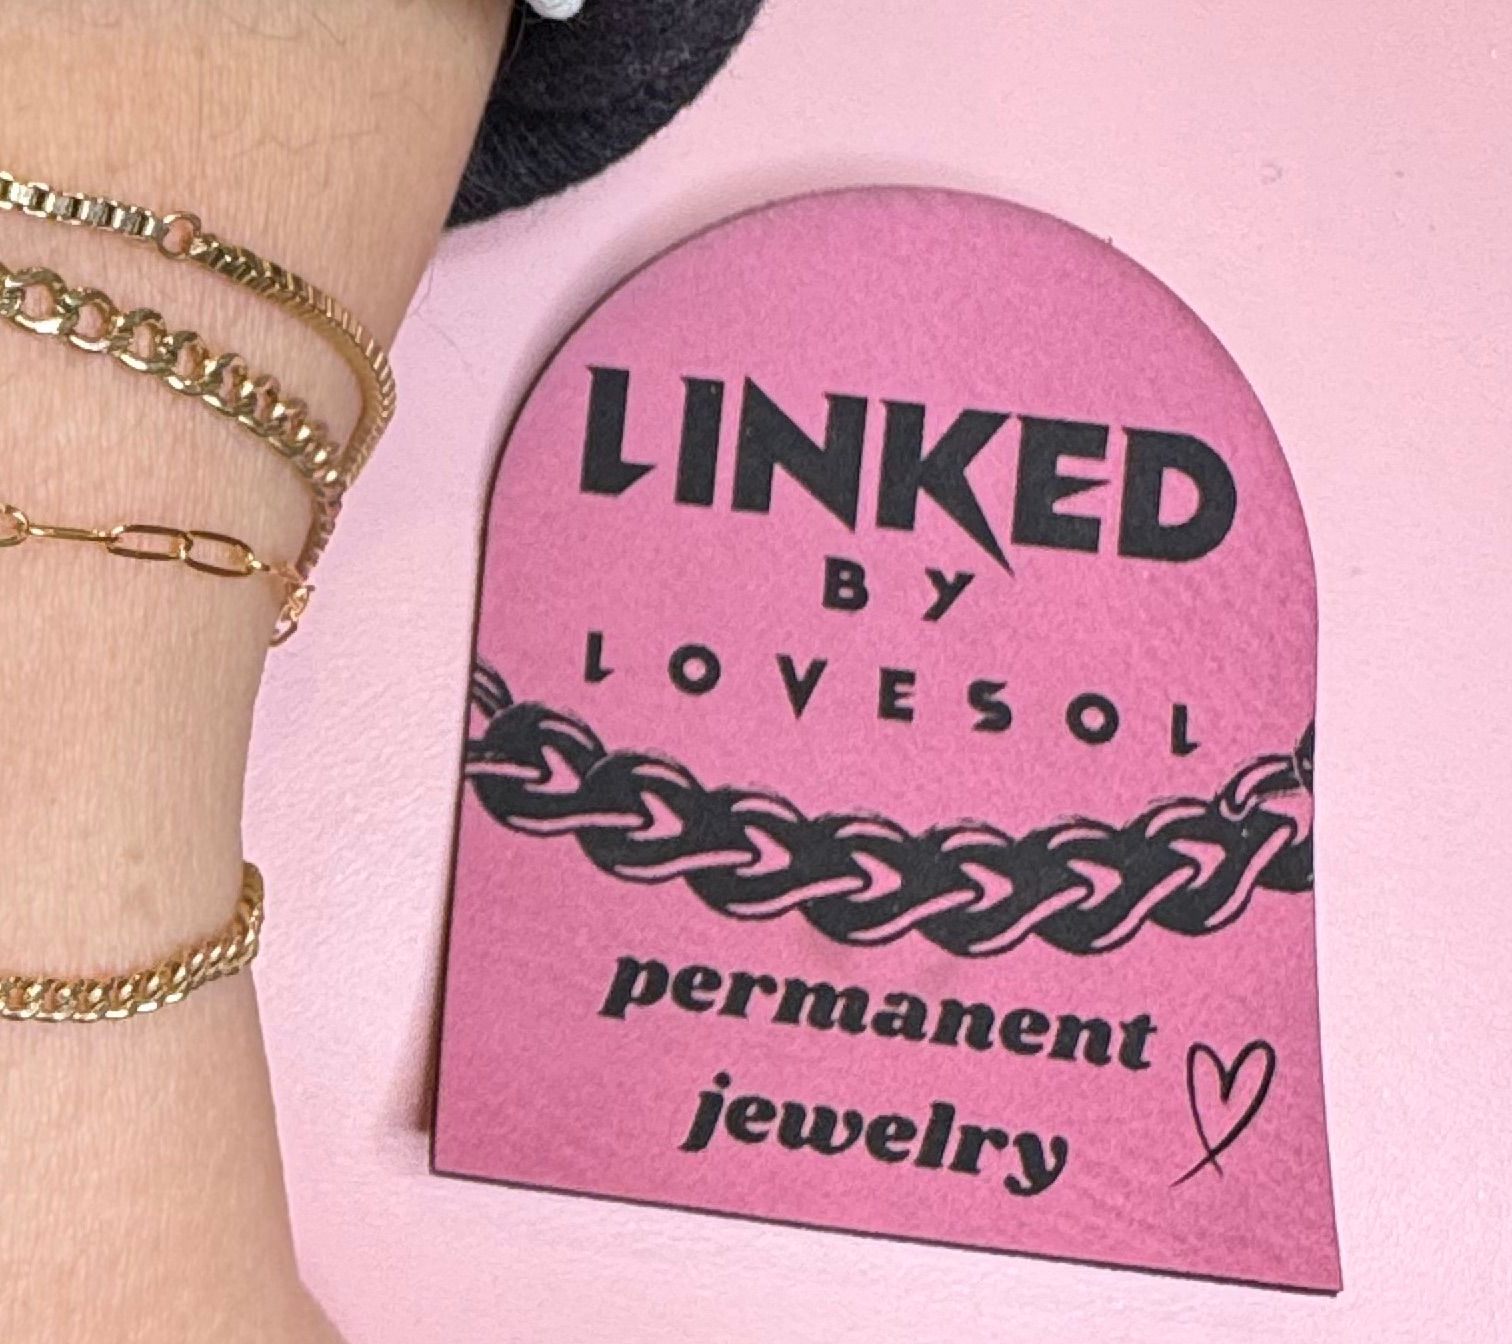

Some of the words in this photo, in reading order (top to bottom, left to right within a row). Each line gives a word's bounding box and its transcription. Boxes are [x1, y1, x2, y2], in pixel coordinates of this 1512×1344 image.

[579, 365, 1239, 573] LINKED
[821, 555, 976, 623] BY
[583, 631, 1199, 758] LOVESOL
[597, 955, 1159, 1073] permanent
[679, 1070, 1069, 1198] jewelry
